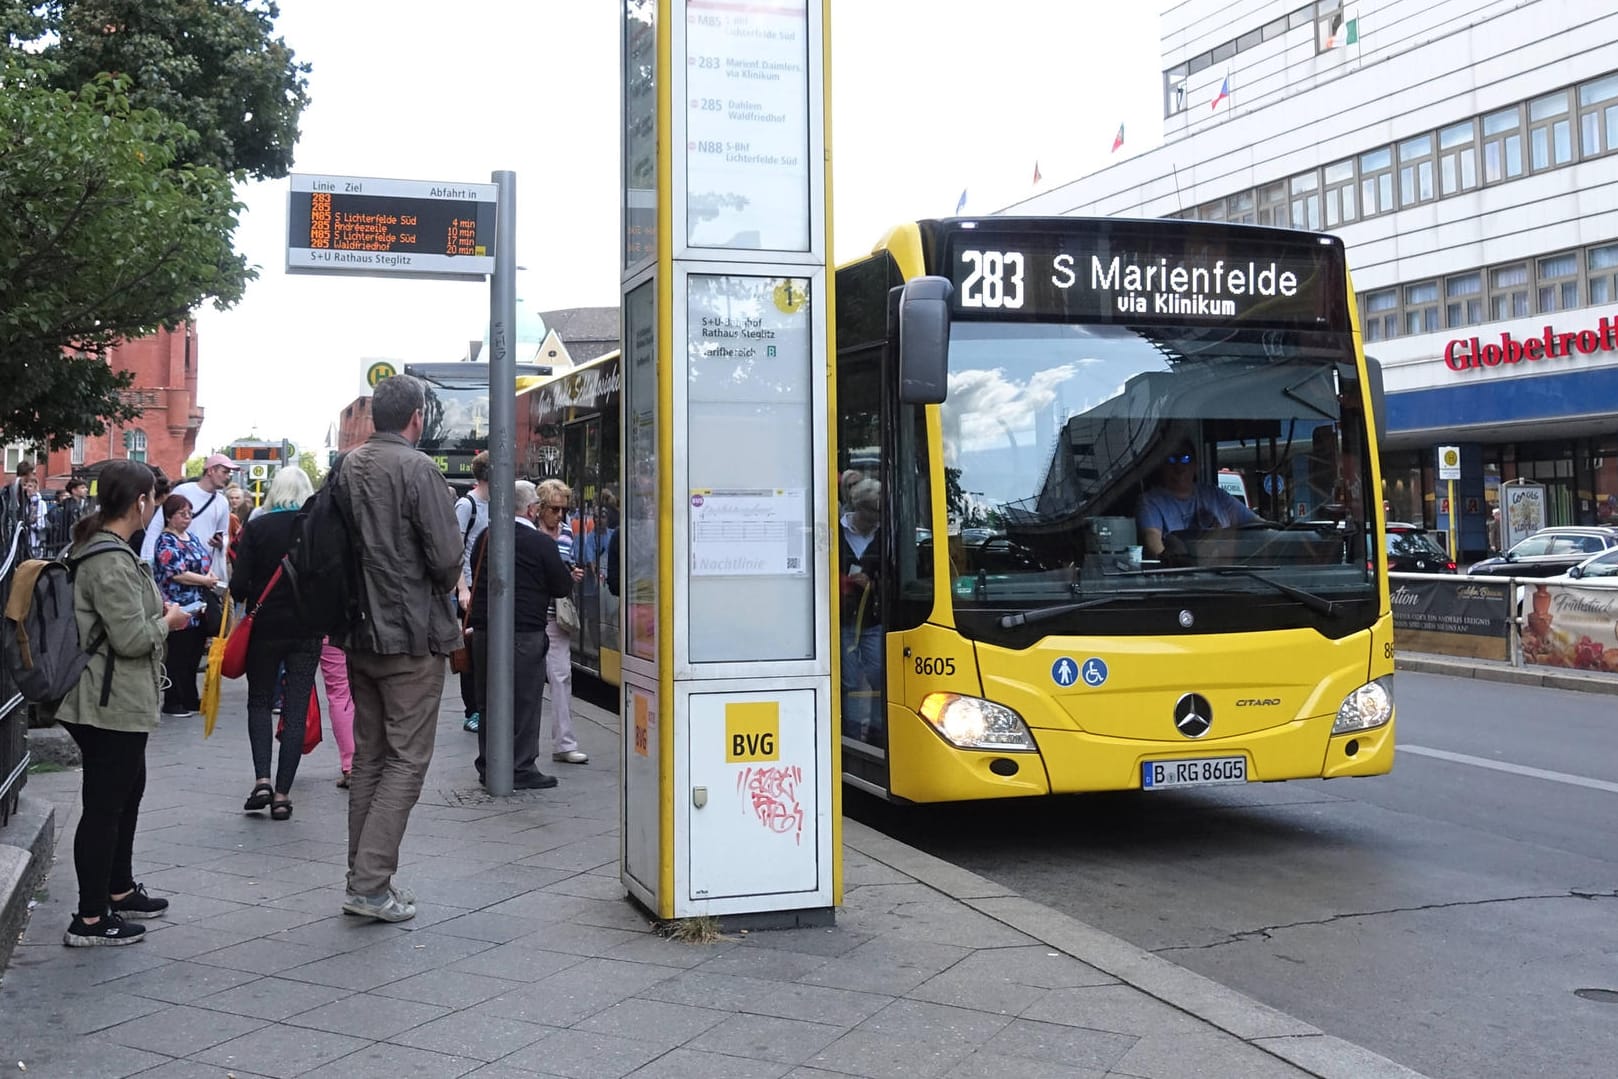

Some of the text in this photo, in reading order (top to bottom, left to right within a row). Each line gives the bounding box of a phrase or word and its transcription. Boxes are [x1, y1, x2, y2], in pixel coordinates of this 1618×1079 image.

[698, 56, 720, 69] 283
[726, 70, 780, 81] via Klinikum
[701, 99, 762, 111] 285 Dahlem
[728, 111, 785, 123] Waldfriedhof
[699, 141, 750, 154] N88 S-Bhf
[726, 153, 797, 166] Lichterfelde Süd
[312, 181, 477, 199] Linie Ziel Abfahrt in
[312, 193, 331, 202] 283
[312, 202, 331, 211] 285
[311, 211, 475, 228] M85 S Lichterfelde Süd 4 min
[311, 220, 330, 230] 285
[447, 227, 458, 236] 10
[459, 228, 475, 237] min
[311, 229, 474, 246] M85 S Lichterfelde Süd 17 min
[311, 239, 330, 248] 285
[333, 239, 391, 251] Waldfriedhof
[446, 244, 457, 254] 20
[458, 246, 474, 255] min
[311, 251, 412, 267] S+U Rathaus Steglitz
[961, 250, 1298, 309] 283 S Marienfelde
[783, 285, 794, 307] 1
[1117, 293, 1236, 316] via Klinikum
[702, 317, 762, 328] S+U-hof
[702, 328, 776, 341] Rathaus Steglitz
[703, 346, 756, 357] arifbereich
[1444, 315, 1618, 372] Globetrot
[1553, 592, 1615, 613] Frühstück
[914, 656, 956, 677] 8605
[1235, 698, 1281, 707] CITARO
[732, 733, 774, 757] BVG
[1154, 765, 1165, 784] B
[1177, 763, 1198, 783] RG
[1202, 760, 1243, 781] 8605
